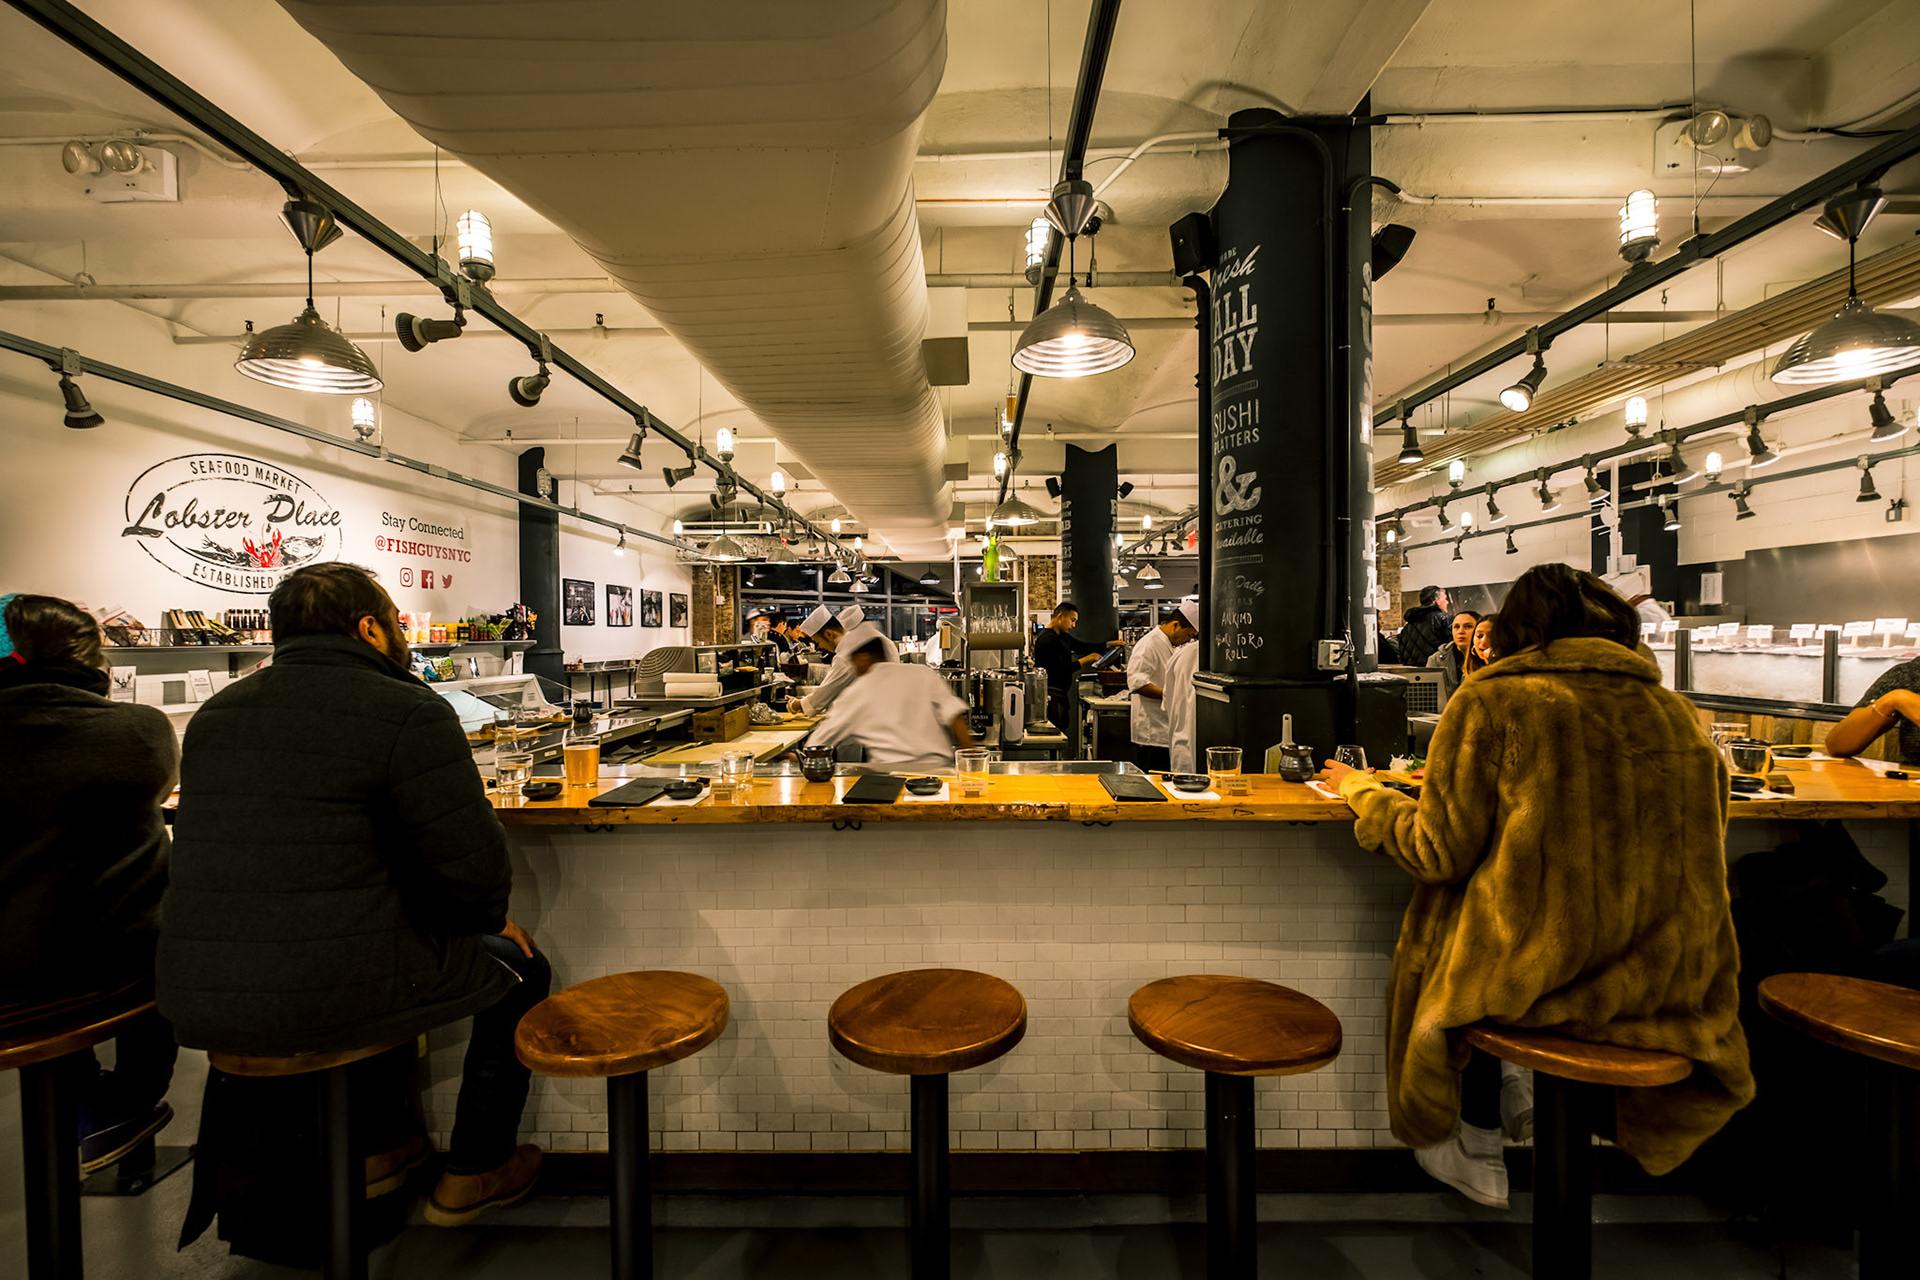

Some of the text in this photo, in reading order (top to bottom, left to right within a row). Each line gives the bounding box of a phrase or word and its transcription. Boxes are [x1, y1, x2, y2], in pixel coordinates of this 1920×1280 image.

[1213, 283, 1258, 344] ALL
[1213, 326, 1259, 388] DAY
[1213, 398, 1260, 438] SUSHI
[189, 460, 301, 495] SEAFOOD MARKET
[1215, 455, 1262, 516] &
[121, 491, 342, 538] Lobster Place
[381, 511, 465, 540] Stay Connected
[1215, 514, 1263, 533] CATERING
[374, 534, 472, 563] @FISHGUYSNYC
[192, 562, 274, 589] ESTABLISHED
[1234, 575, 1266, 597] Daily
[1236, 632, 1264, 649] TORO
[1225, 651, 1249, 662] ROLL
